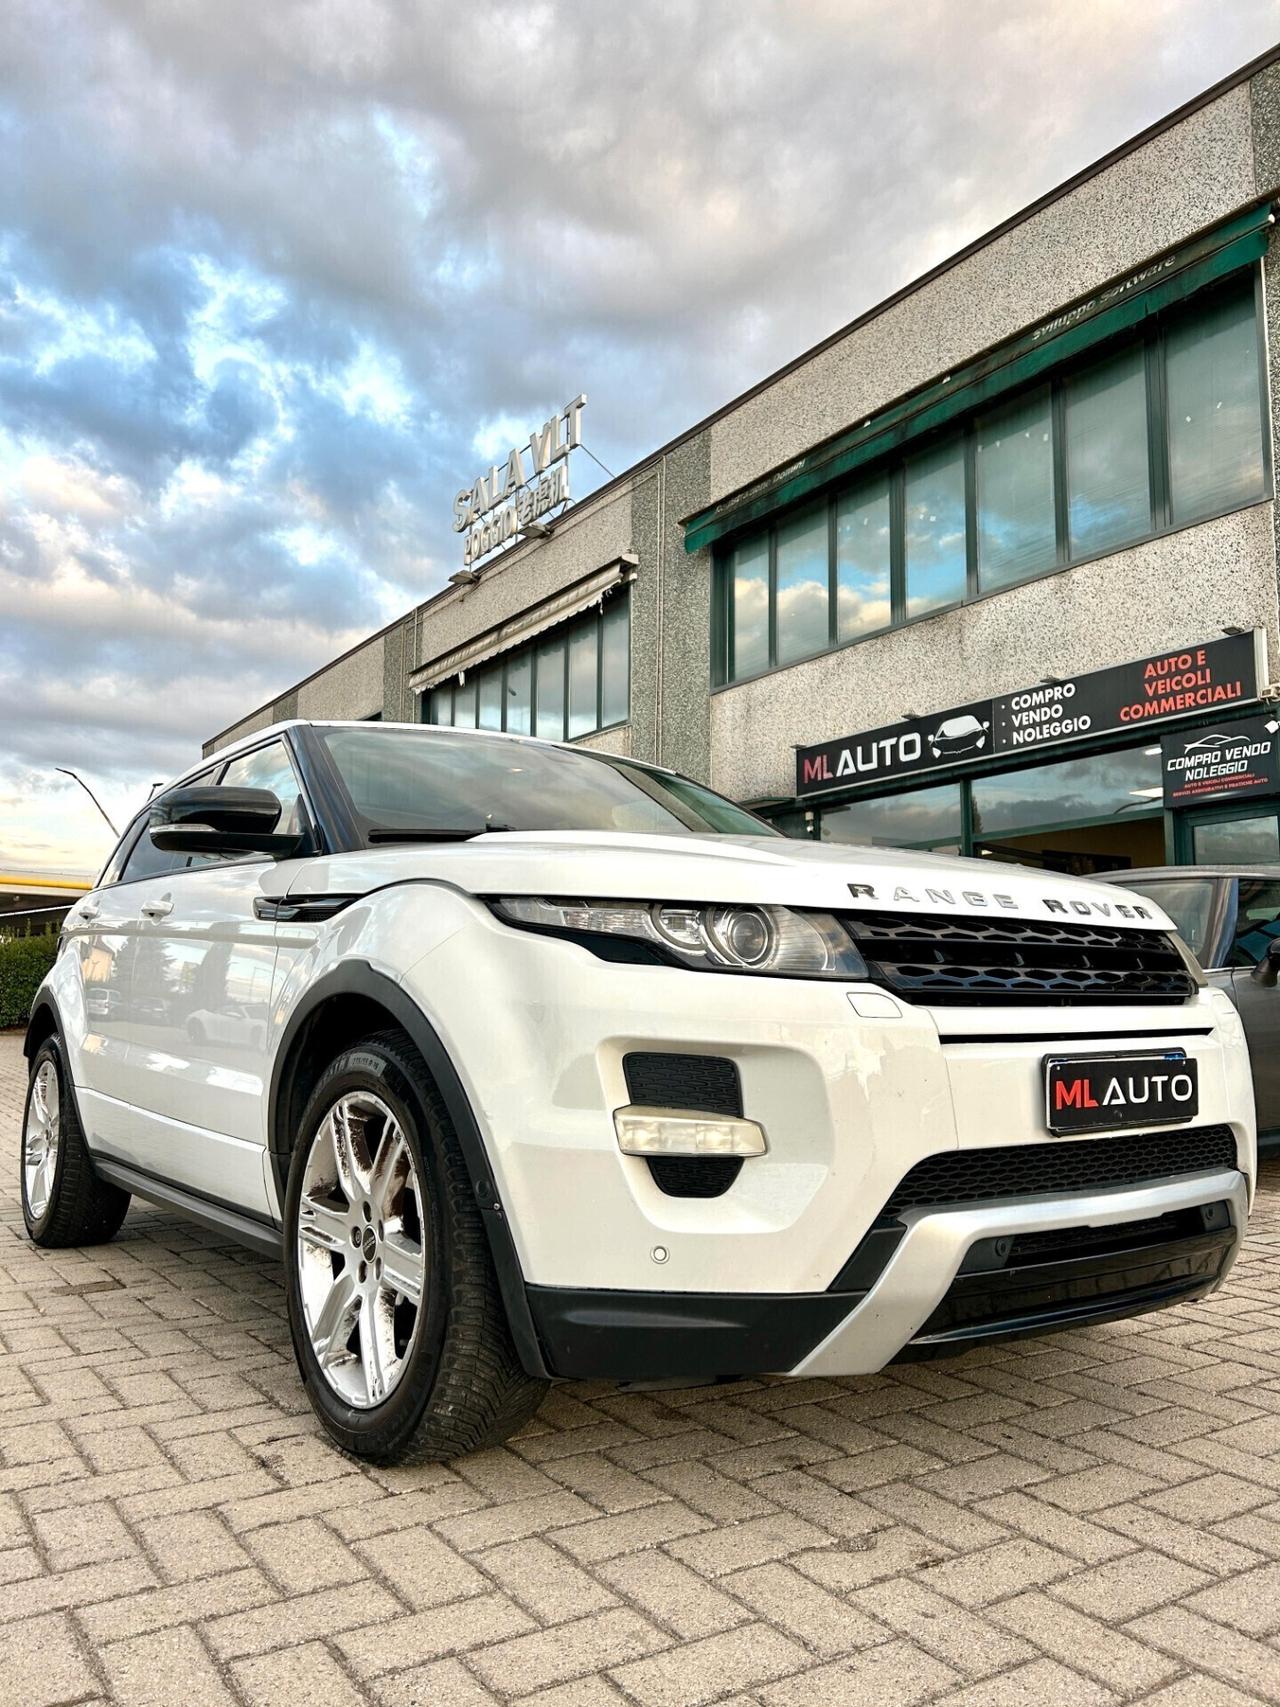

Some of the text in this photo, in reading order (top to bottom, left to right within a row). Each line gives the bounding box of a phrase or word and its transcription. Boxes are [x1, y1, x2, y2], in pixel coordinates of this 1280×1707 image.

[453, 394, 587, 532] SALA VLT
[1144, 650, 1206, 679] AUTO E
[1011, 683, 1076, 711] COMPRO
[1144, 669, 1211, 697] VEICOLI
[1011, 704, 1064, 728] VENDO
[1120, 681, 1242, 722] COMMERCIALI
[1012, 715, 1091, 745] NOLEGGIO
[804, 732, 921, 784] ML AUTO
[1167, 741, 1271, 771] COMPRO VENDO
[1185, 760, 1248, 781] NOLEGGIO
[847, 883, 1153, 920] RANGE ROVER
[1056, 1074, 1193, 1110] ML AUTO
